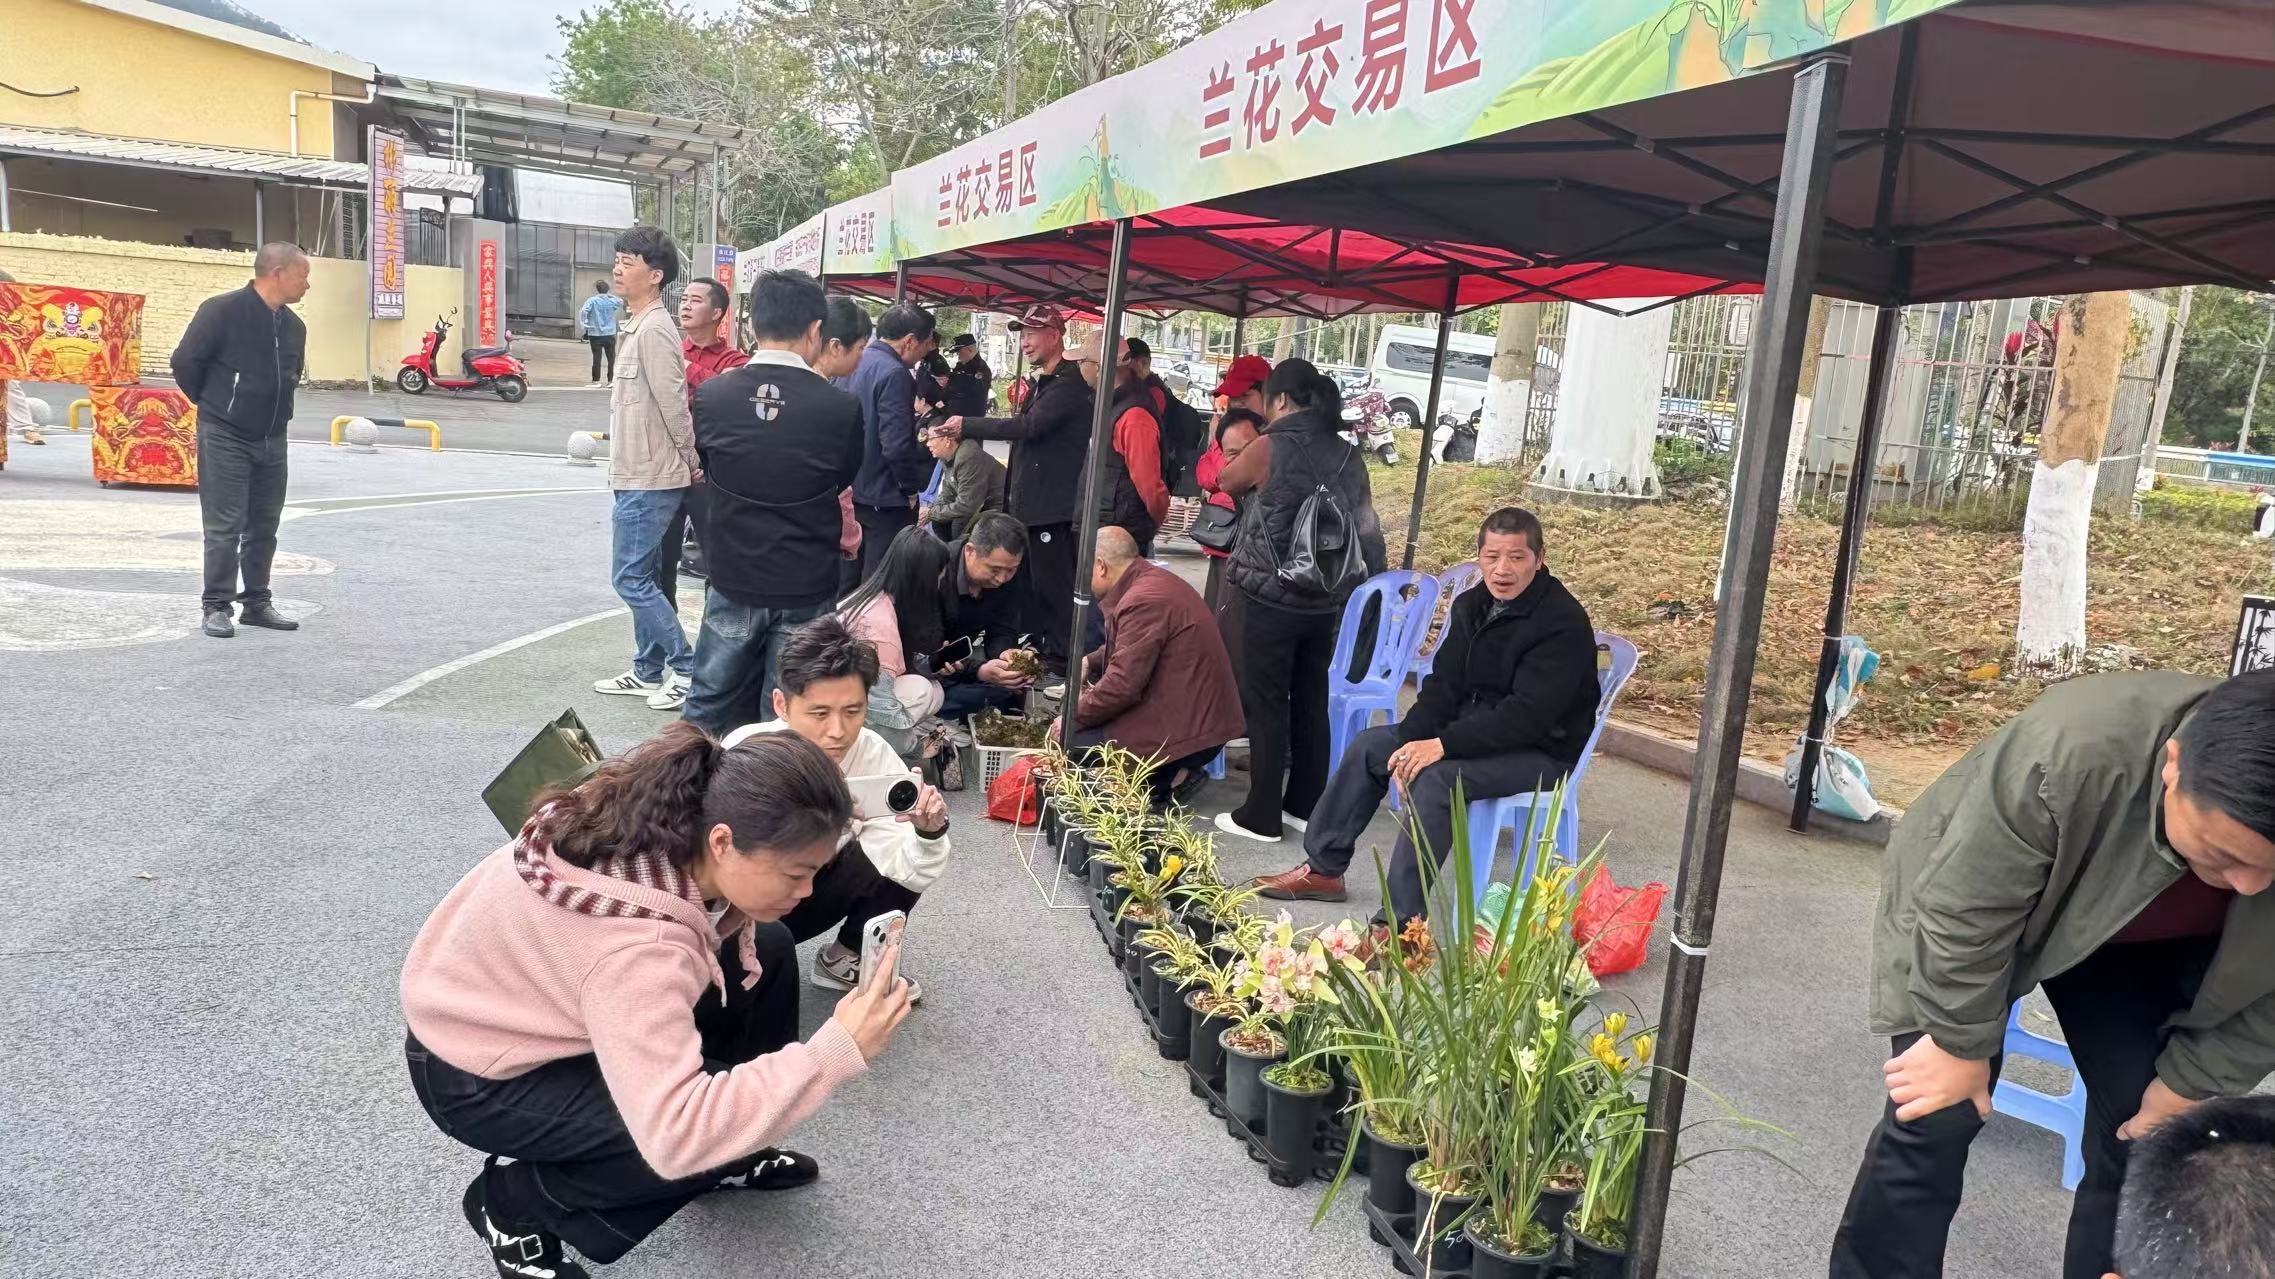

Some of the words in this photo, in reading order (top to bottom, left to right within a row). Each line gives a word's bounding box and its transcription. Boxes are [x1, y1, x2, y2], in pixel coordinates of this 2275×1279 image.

[1199, 0, 1482, 159] 兰花交易区
[937, 140, 1038, 228] 兰花交易区
